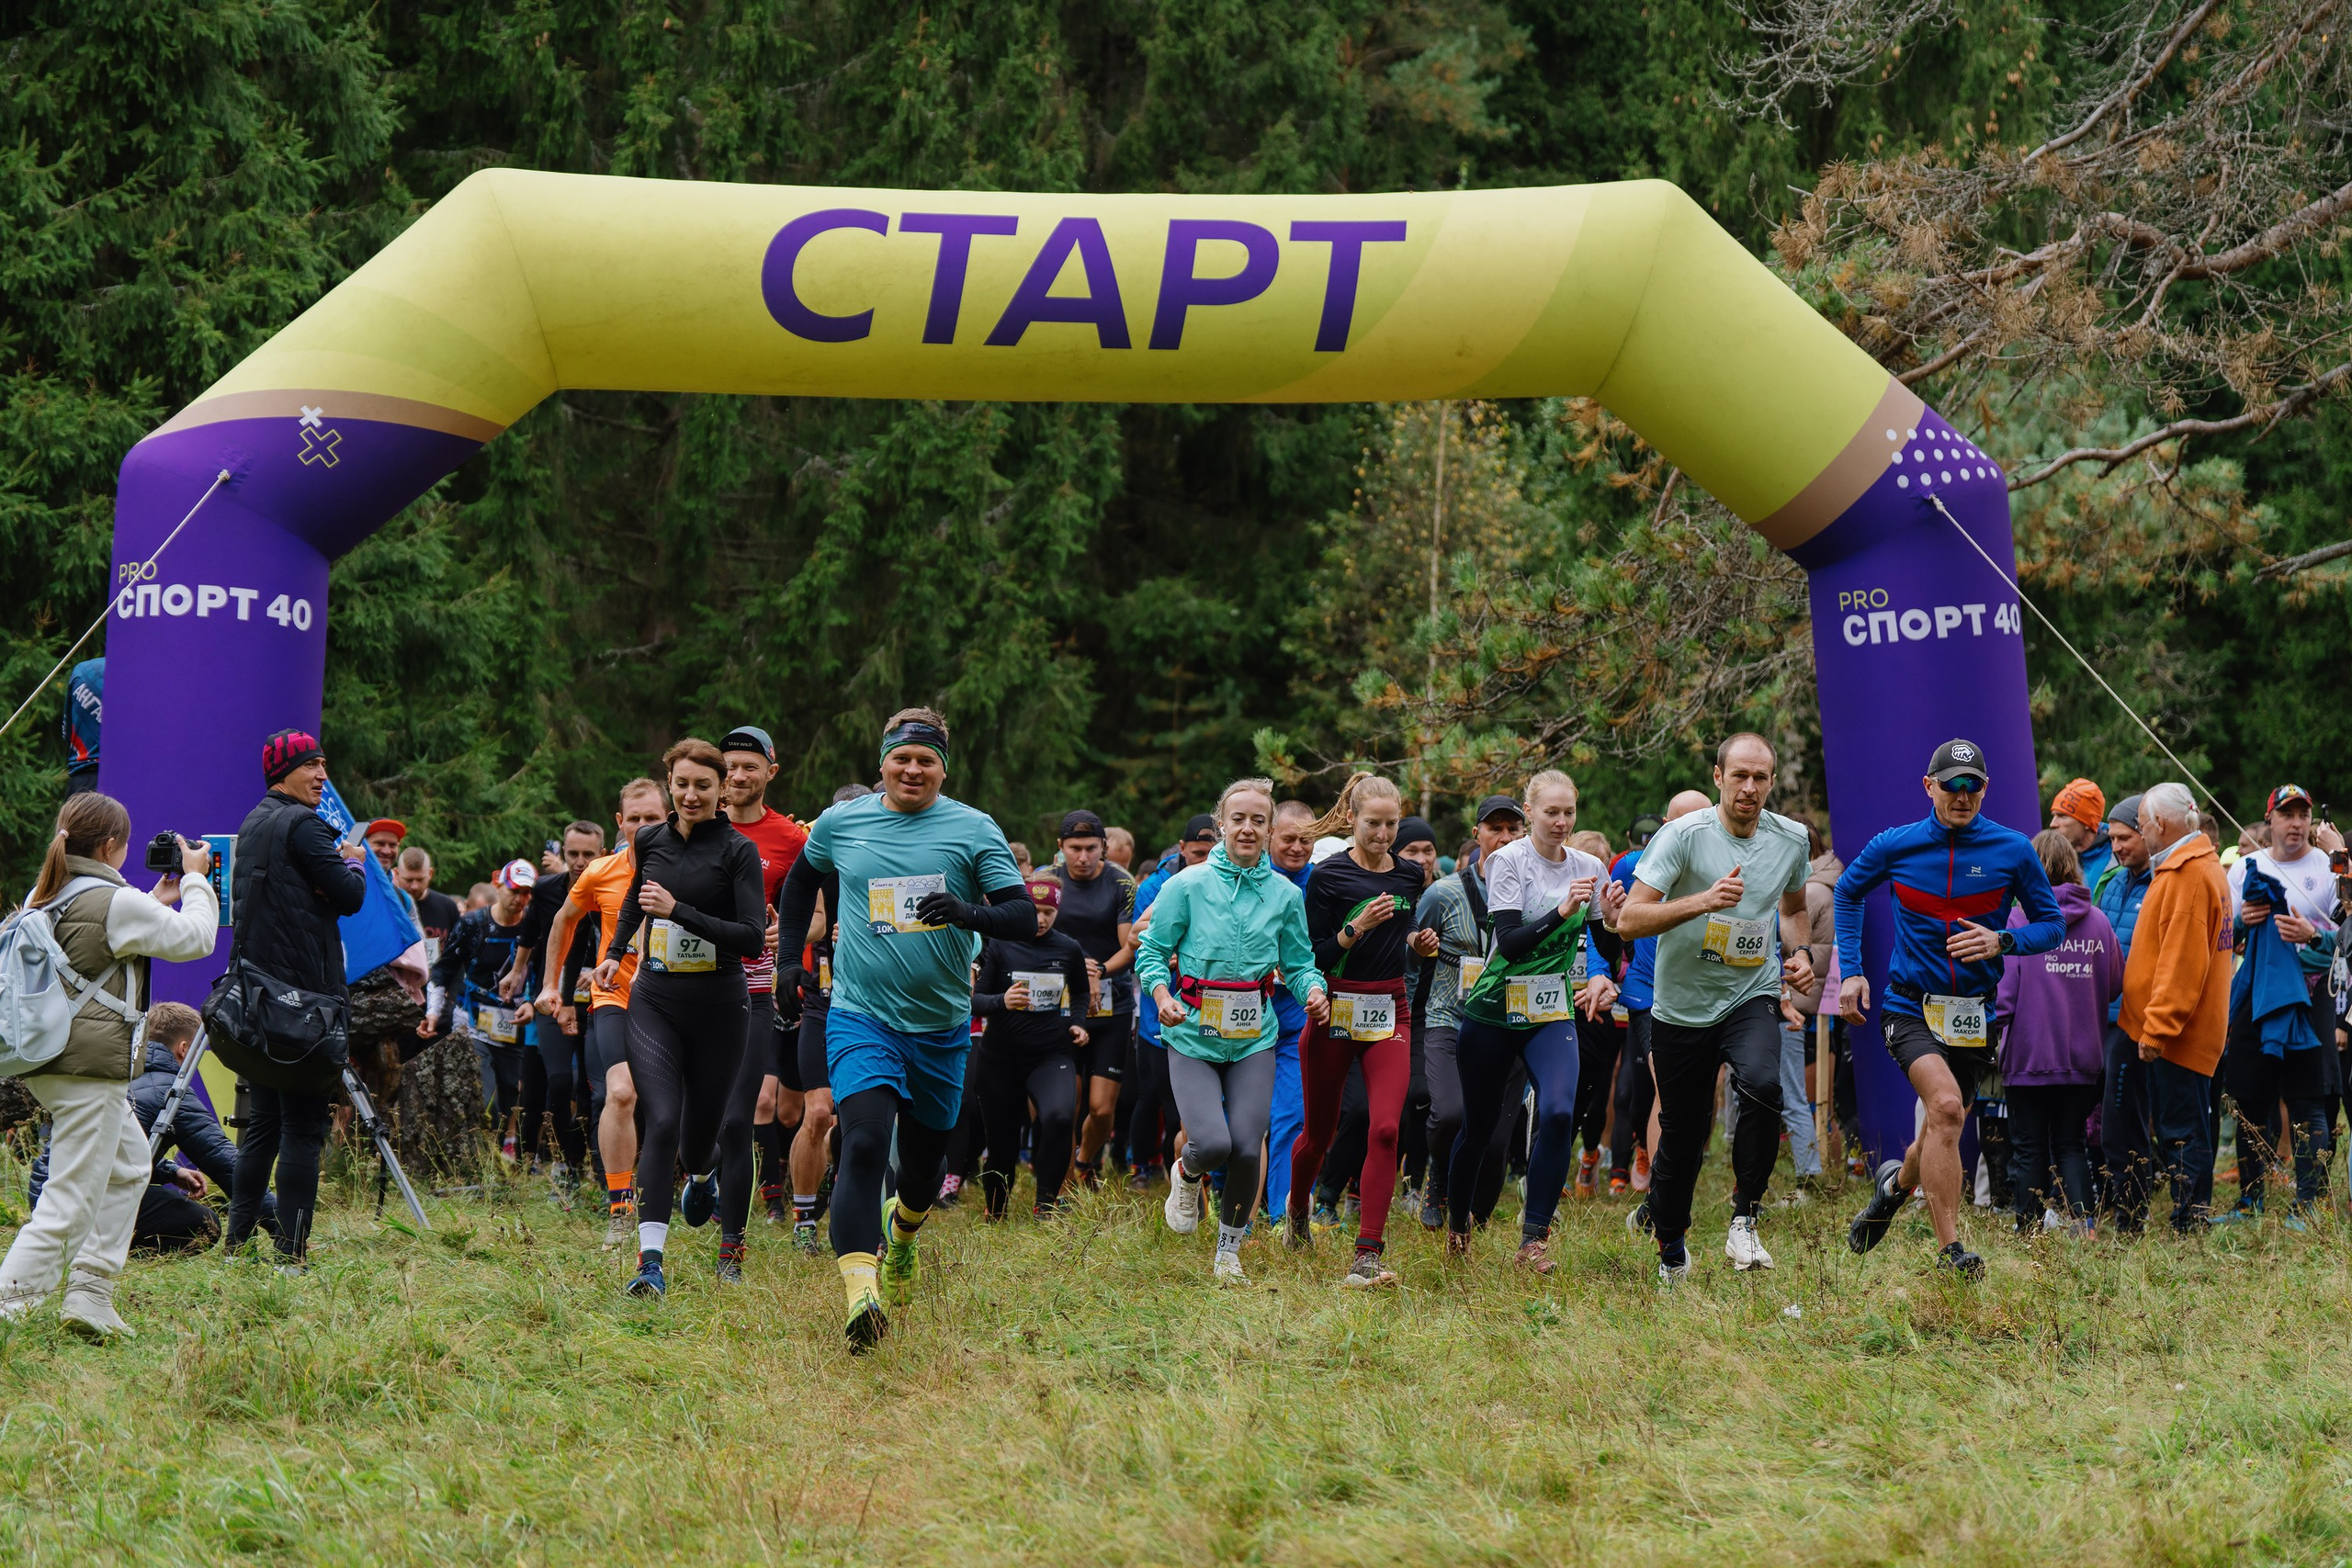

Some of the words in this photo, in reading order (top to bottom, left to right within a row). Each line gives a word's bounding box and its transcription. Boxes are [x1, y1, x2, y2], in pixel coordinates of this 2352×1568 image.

[761, 208, 1407, 352] СТАРТ
[119, 560, 157, 584] PRO
[1839, 588, 1889, 612] PRO
[117, 583, 259, 619] СПОРТ
[266, 593, 311, 631] 40
[1843, 604, 1986, 646] СПОРТ
[1994, 603, 2020, 636] 40
[680, 939, 701, 952] 97
[1736, 936, 1763, 950] 868
[1706, 953, 1722, 962] 10K
[1568, 965, 1588, 976] 63
[2045, 963, 2081, 973] СПОРТ
[1032, 989, 1059, 998] 1008.1
[1535, 990, 1559, 1005] 677
[277, 996, 303, 1009] adidas
[1230, 1009, 1257, 1021] 502
[1363, 1010, 1387, 1022] 126
[497, 1020, 513, 1031] 630
[1951, 1015, 1981, 1029] 648
